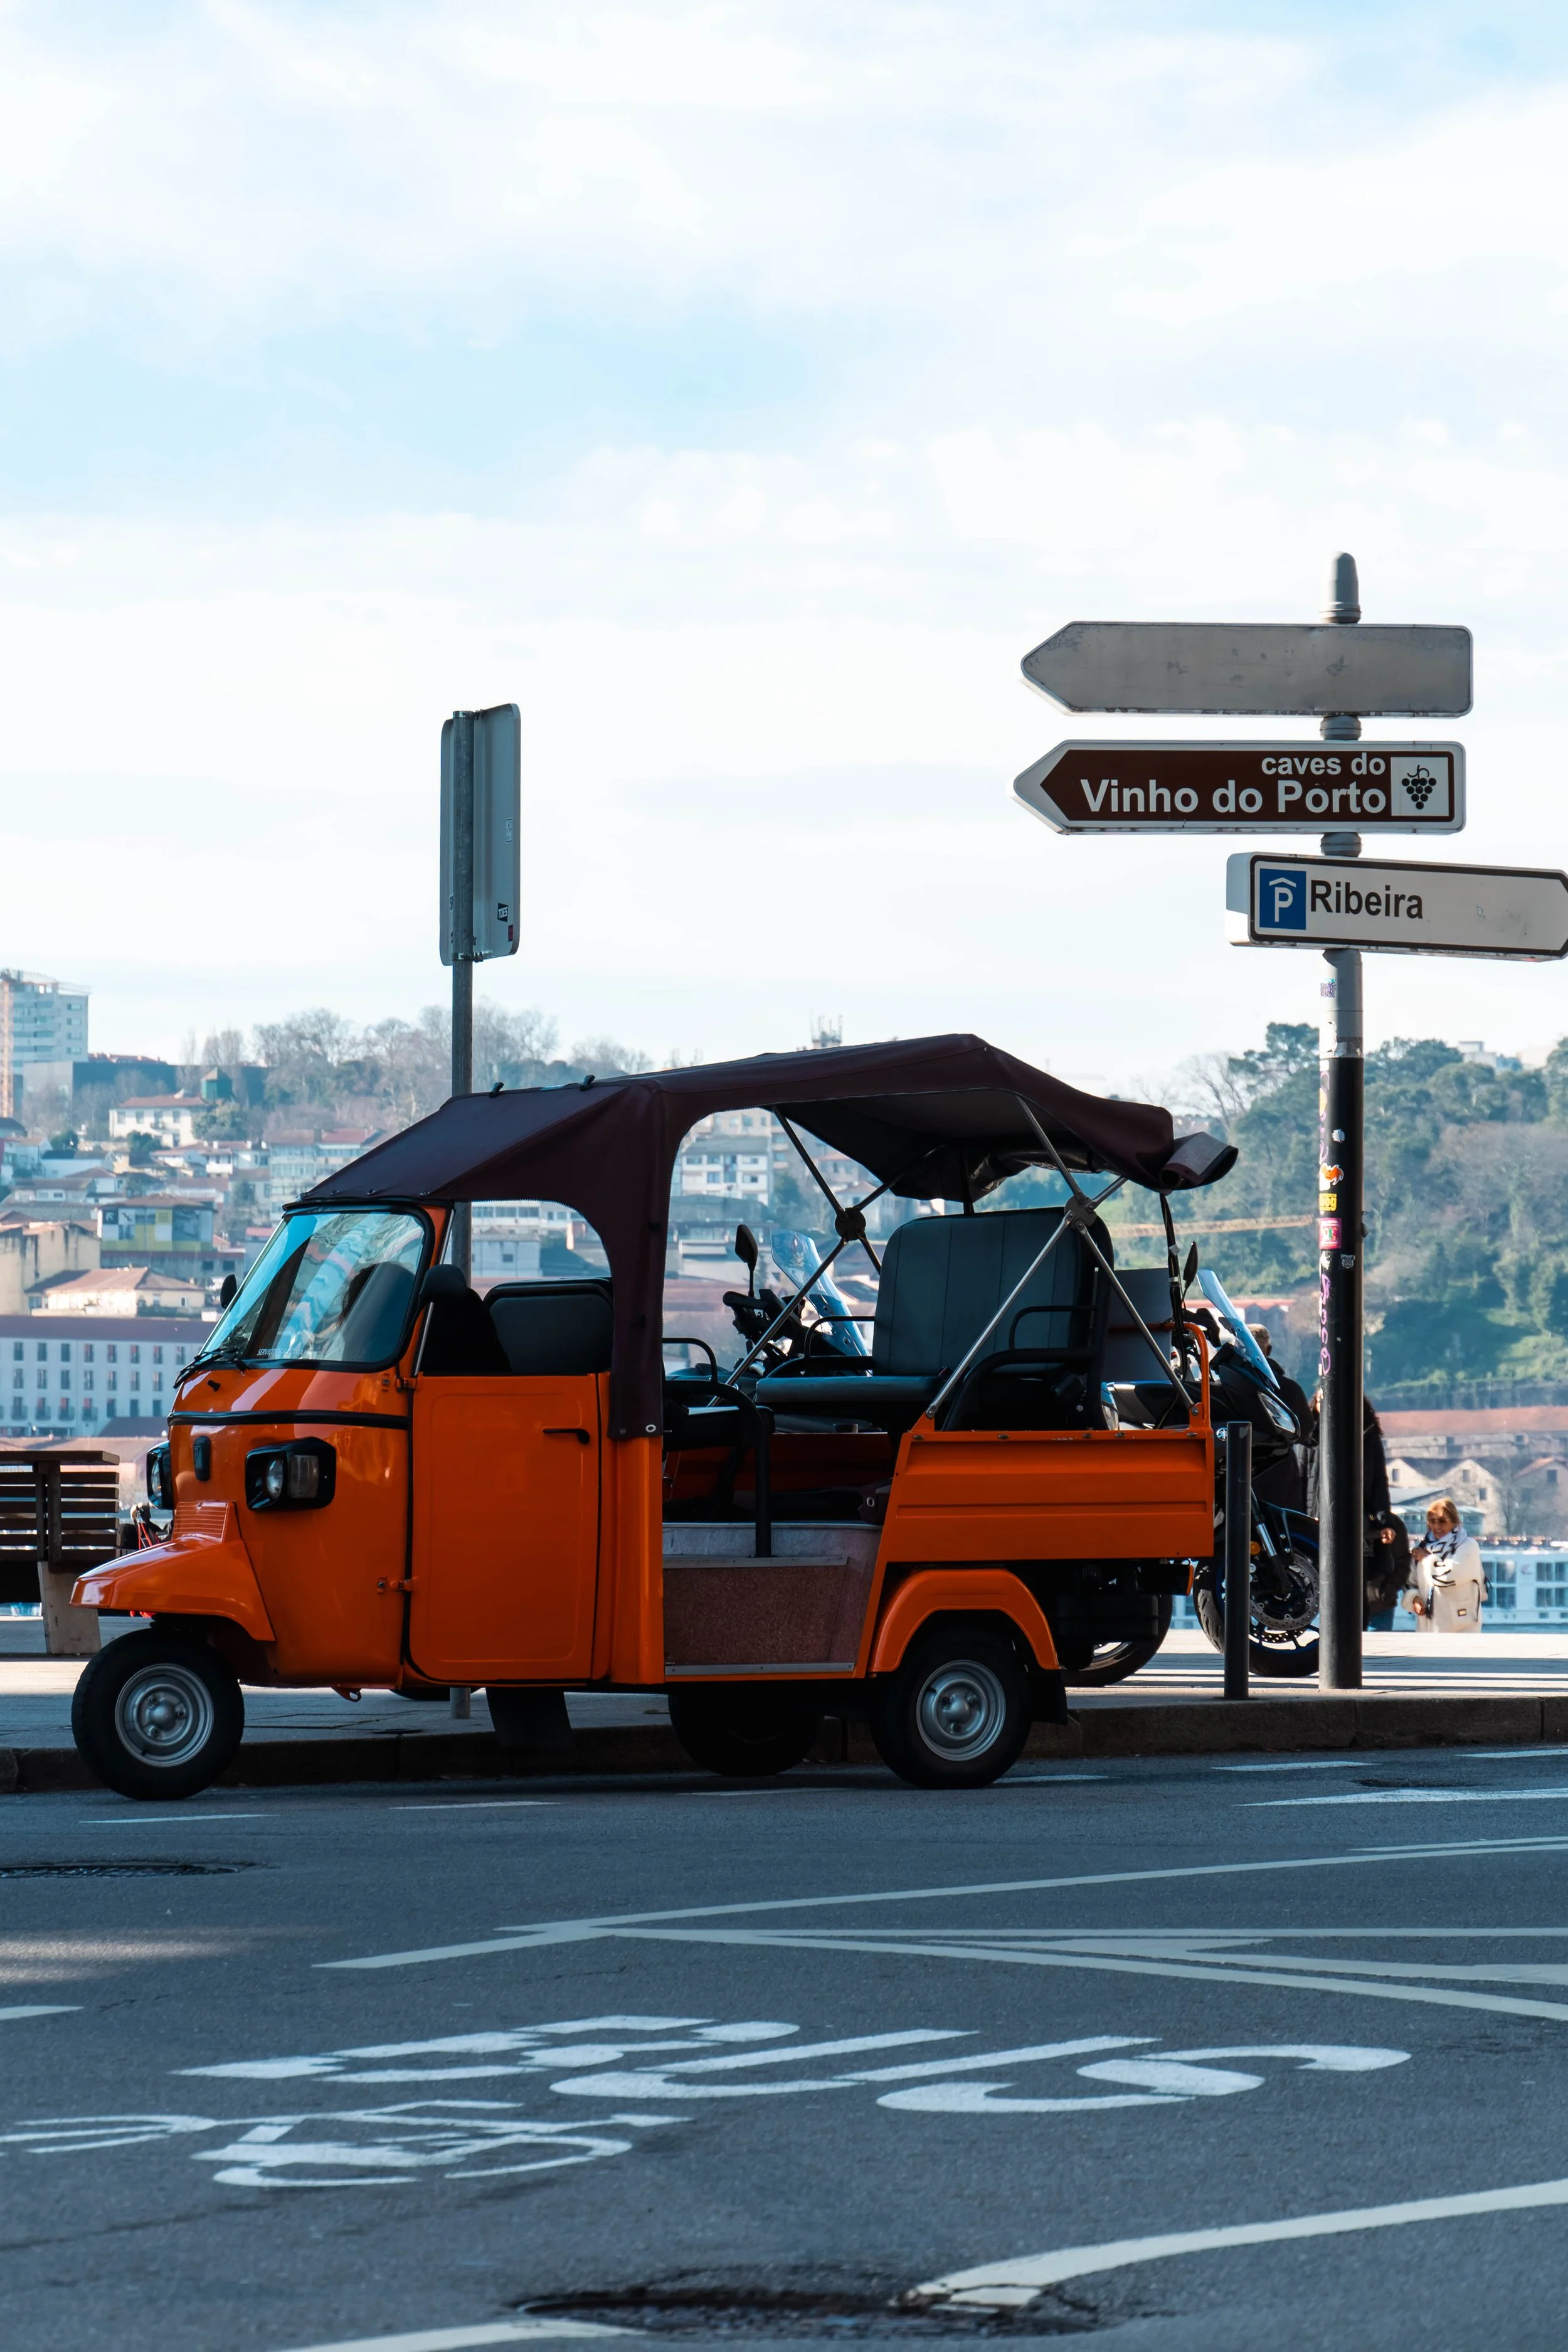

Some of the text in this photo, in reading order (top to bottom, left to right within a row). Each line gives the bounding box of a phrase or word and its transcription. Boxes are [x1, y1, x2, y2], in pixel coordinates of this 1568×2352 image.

[1261, 752, 1386, 775] caves do
[1079, 778, 1387, 813] Vinho do Porto
[1310, 879, 1424, 919] Ribeira
[167, 2015, 1413, 2113] BUS
